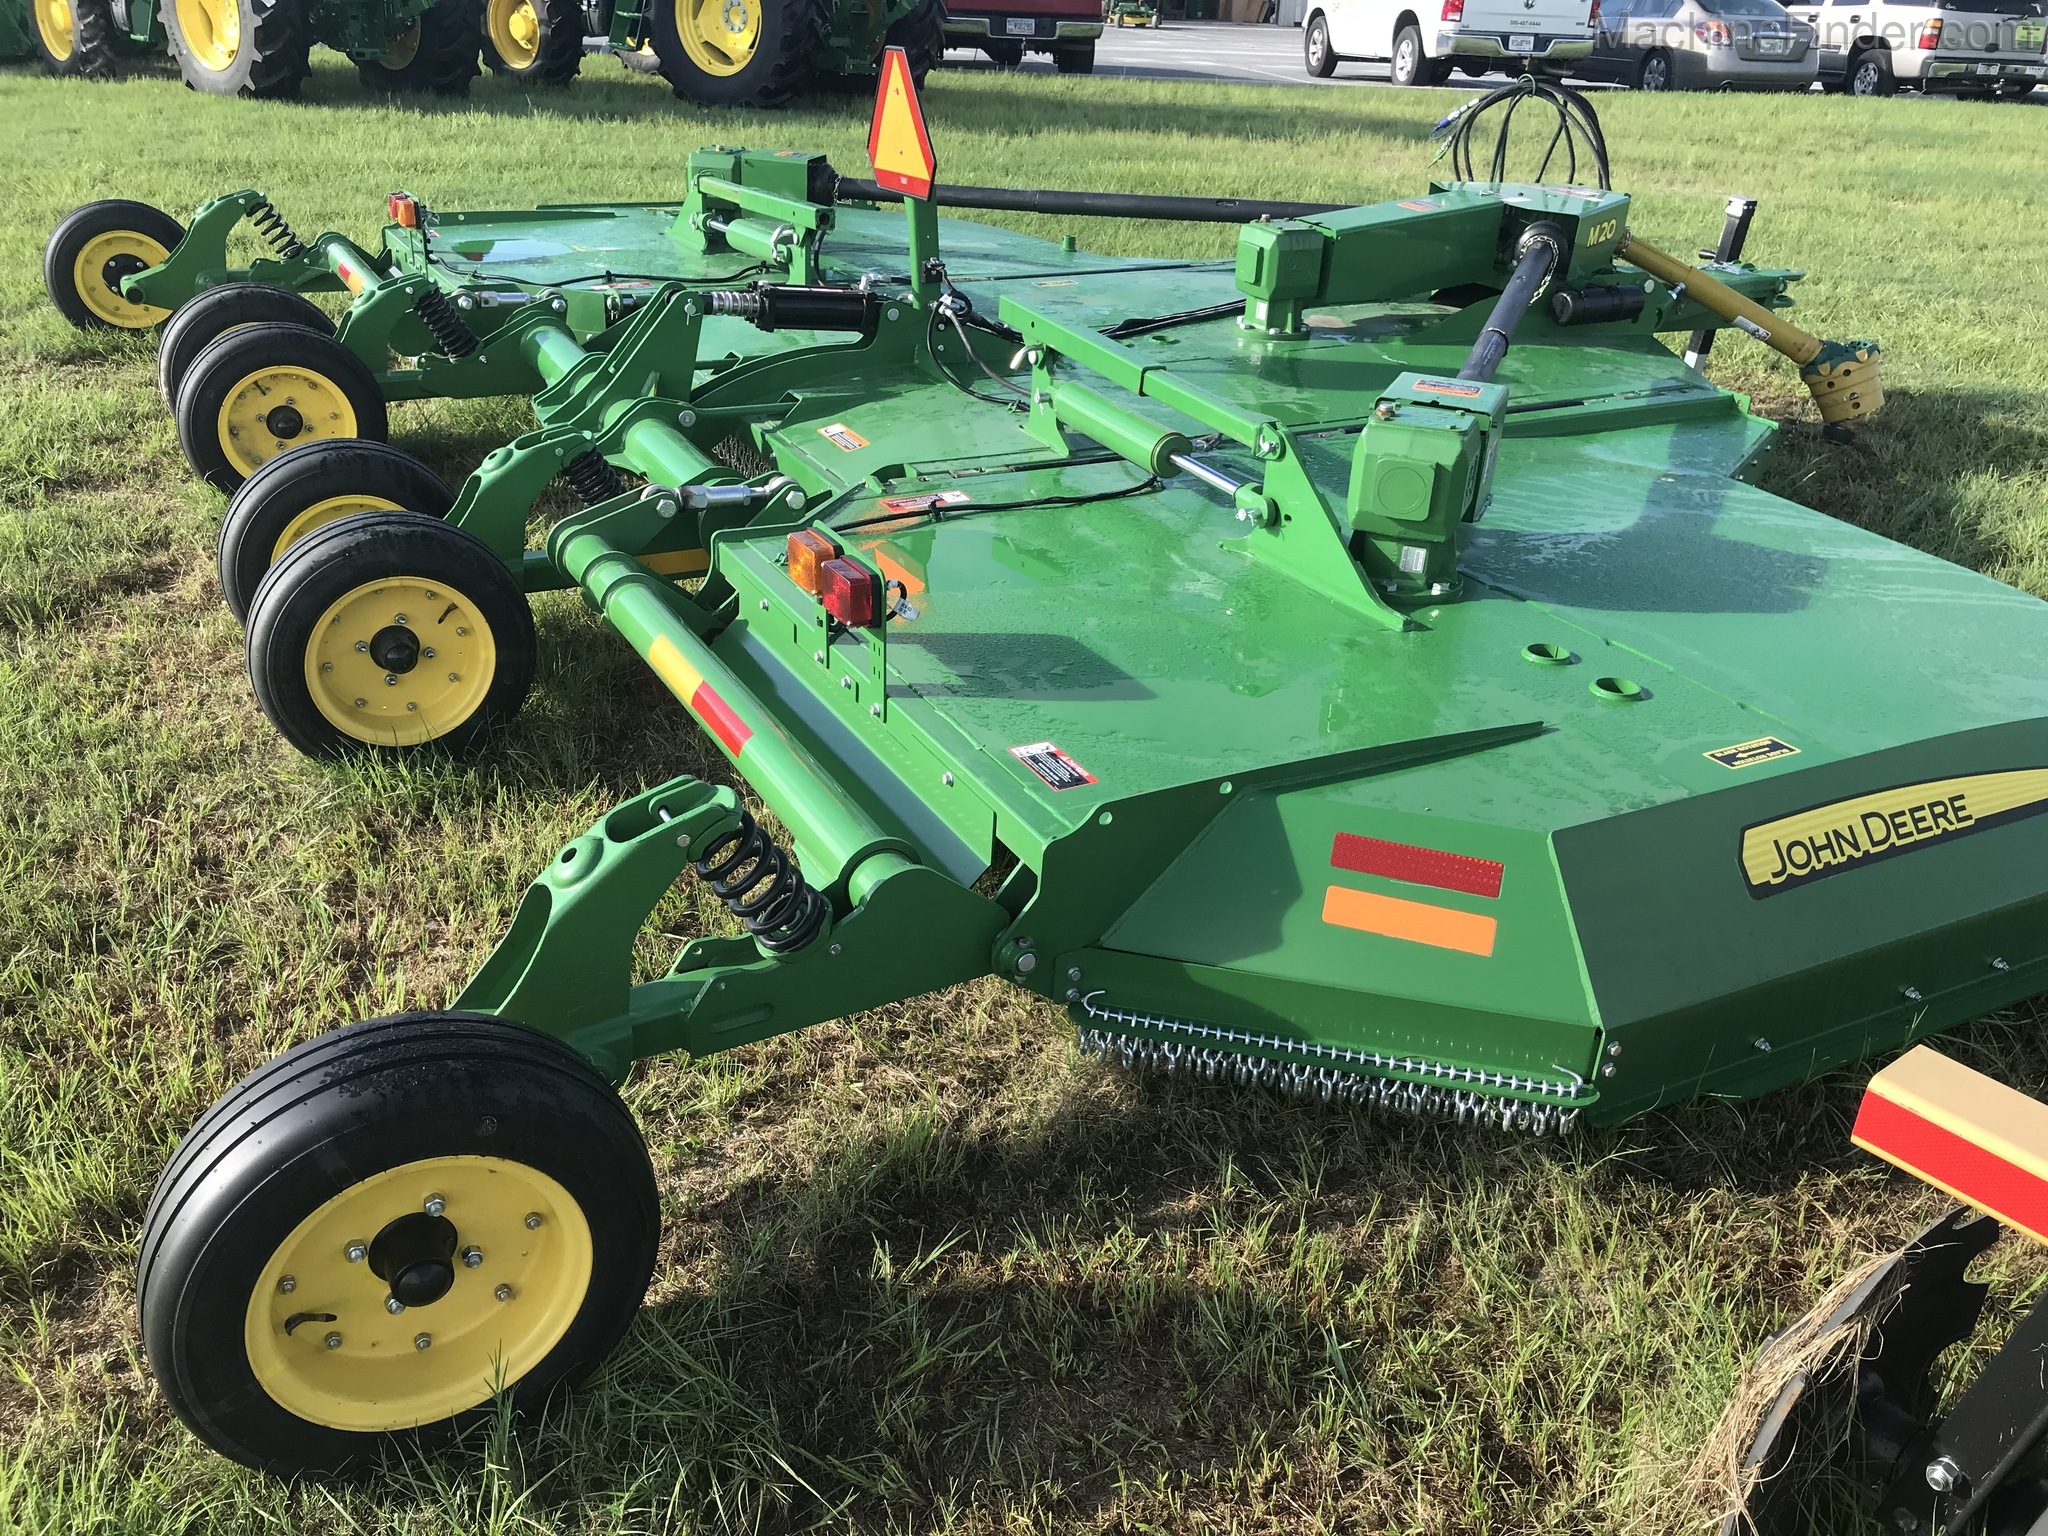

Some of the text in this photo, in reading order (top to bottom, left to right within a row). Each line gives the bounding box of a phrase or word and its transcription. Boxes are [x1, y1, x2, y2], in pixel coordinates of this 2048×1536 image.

[1586, 218, 1617, 248] M20
[1770, 793, 1974, 879] JOHN DEERE
